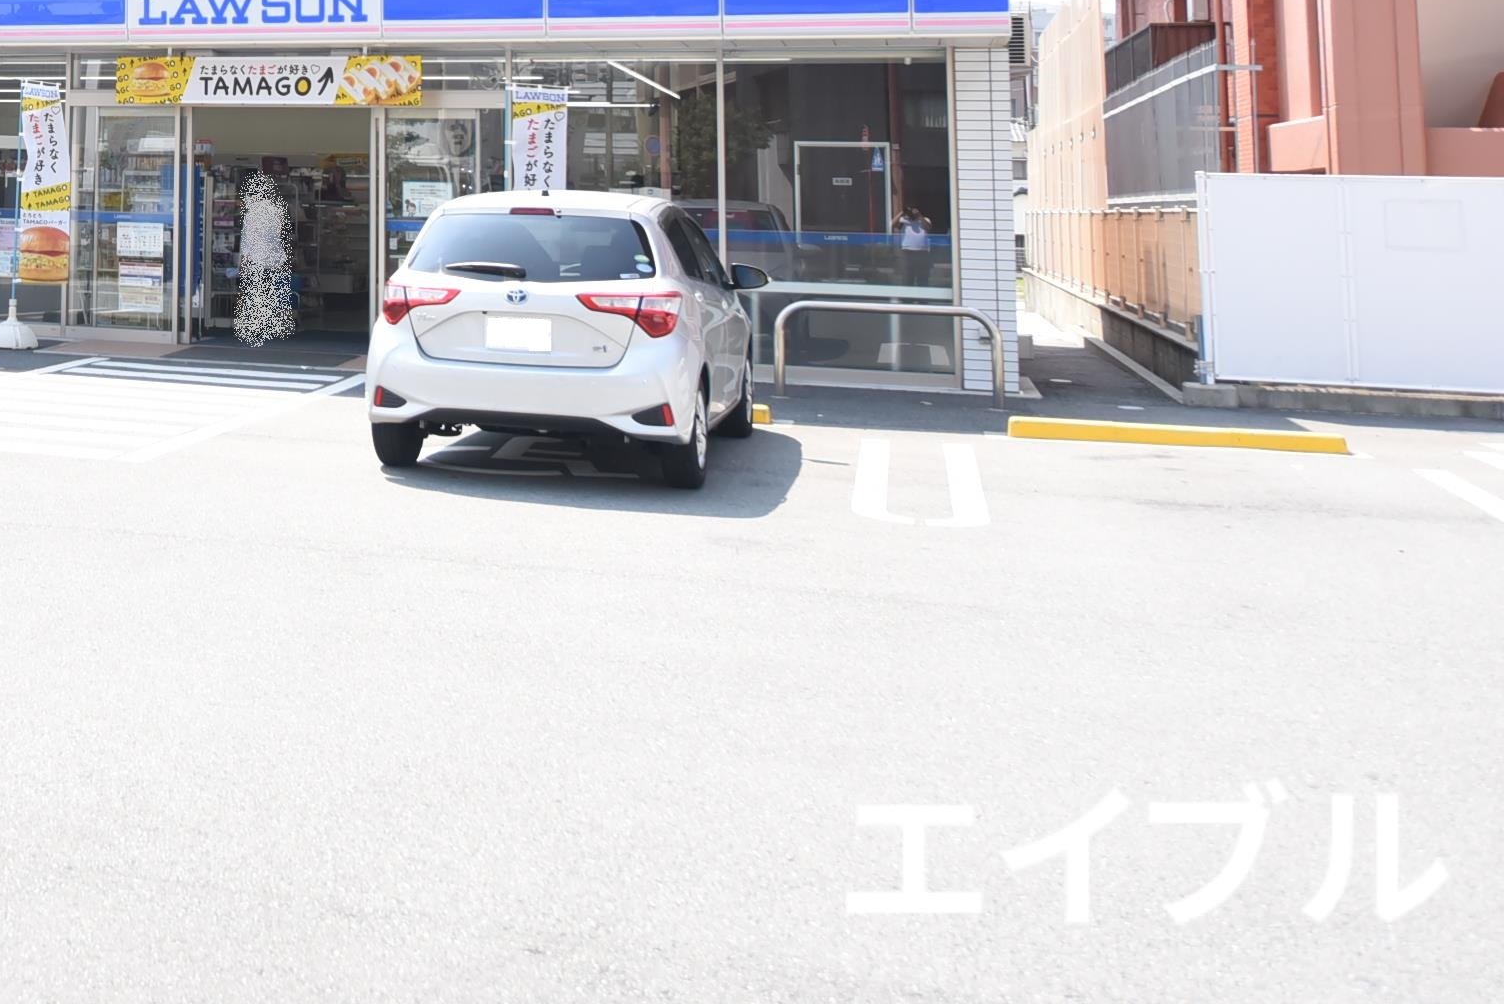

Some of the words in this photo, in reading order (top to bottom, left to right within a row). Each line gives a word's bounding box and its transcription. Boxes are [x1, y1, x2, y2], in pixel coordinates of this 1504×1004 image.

[199, 64, 309, 75] たまらなくたまごが好き
[199, 76, 312, 97] TAMAGO
[515, 91, 565, 102] LAWSON
[29, 113, 46, 186] たまごが好き
[43, 113, 59, 173] たまらなく
[524, 118, 539, 190] たまごが好
[542, 118, 556, 188] たまらなく
